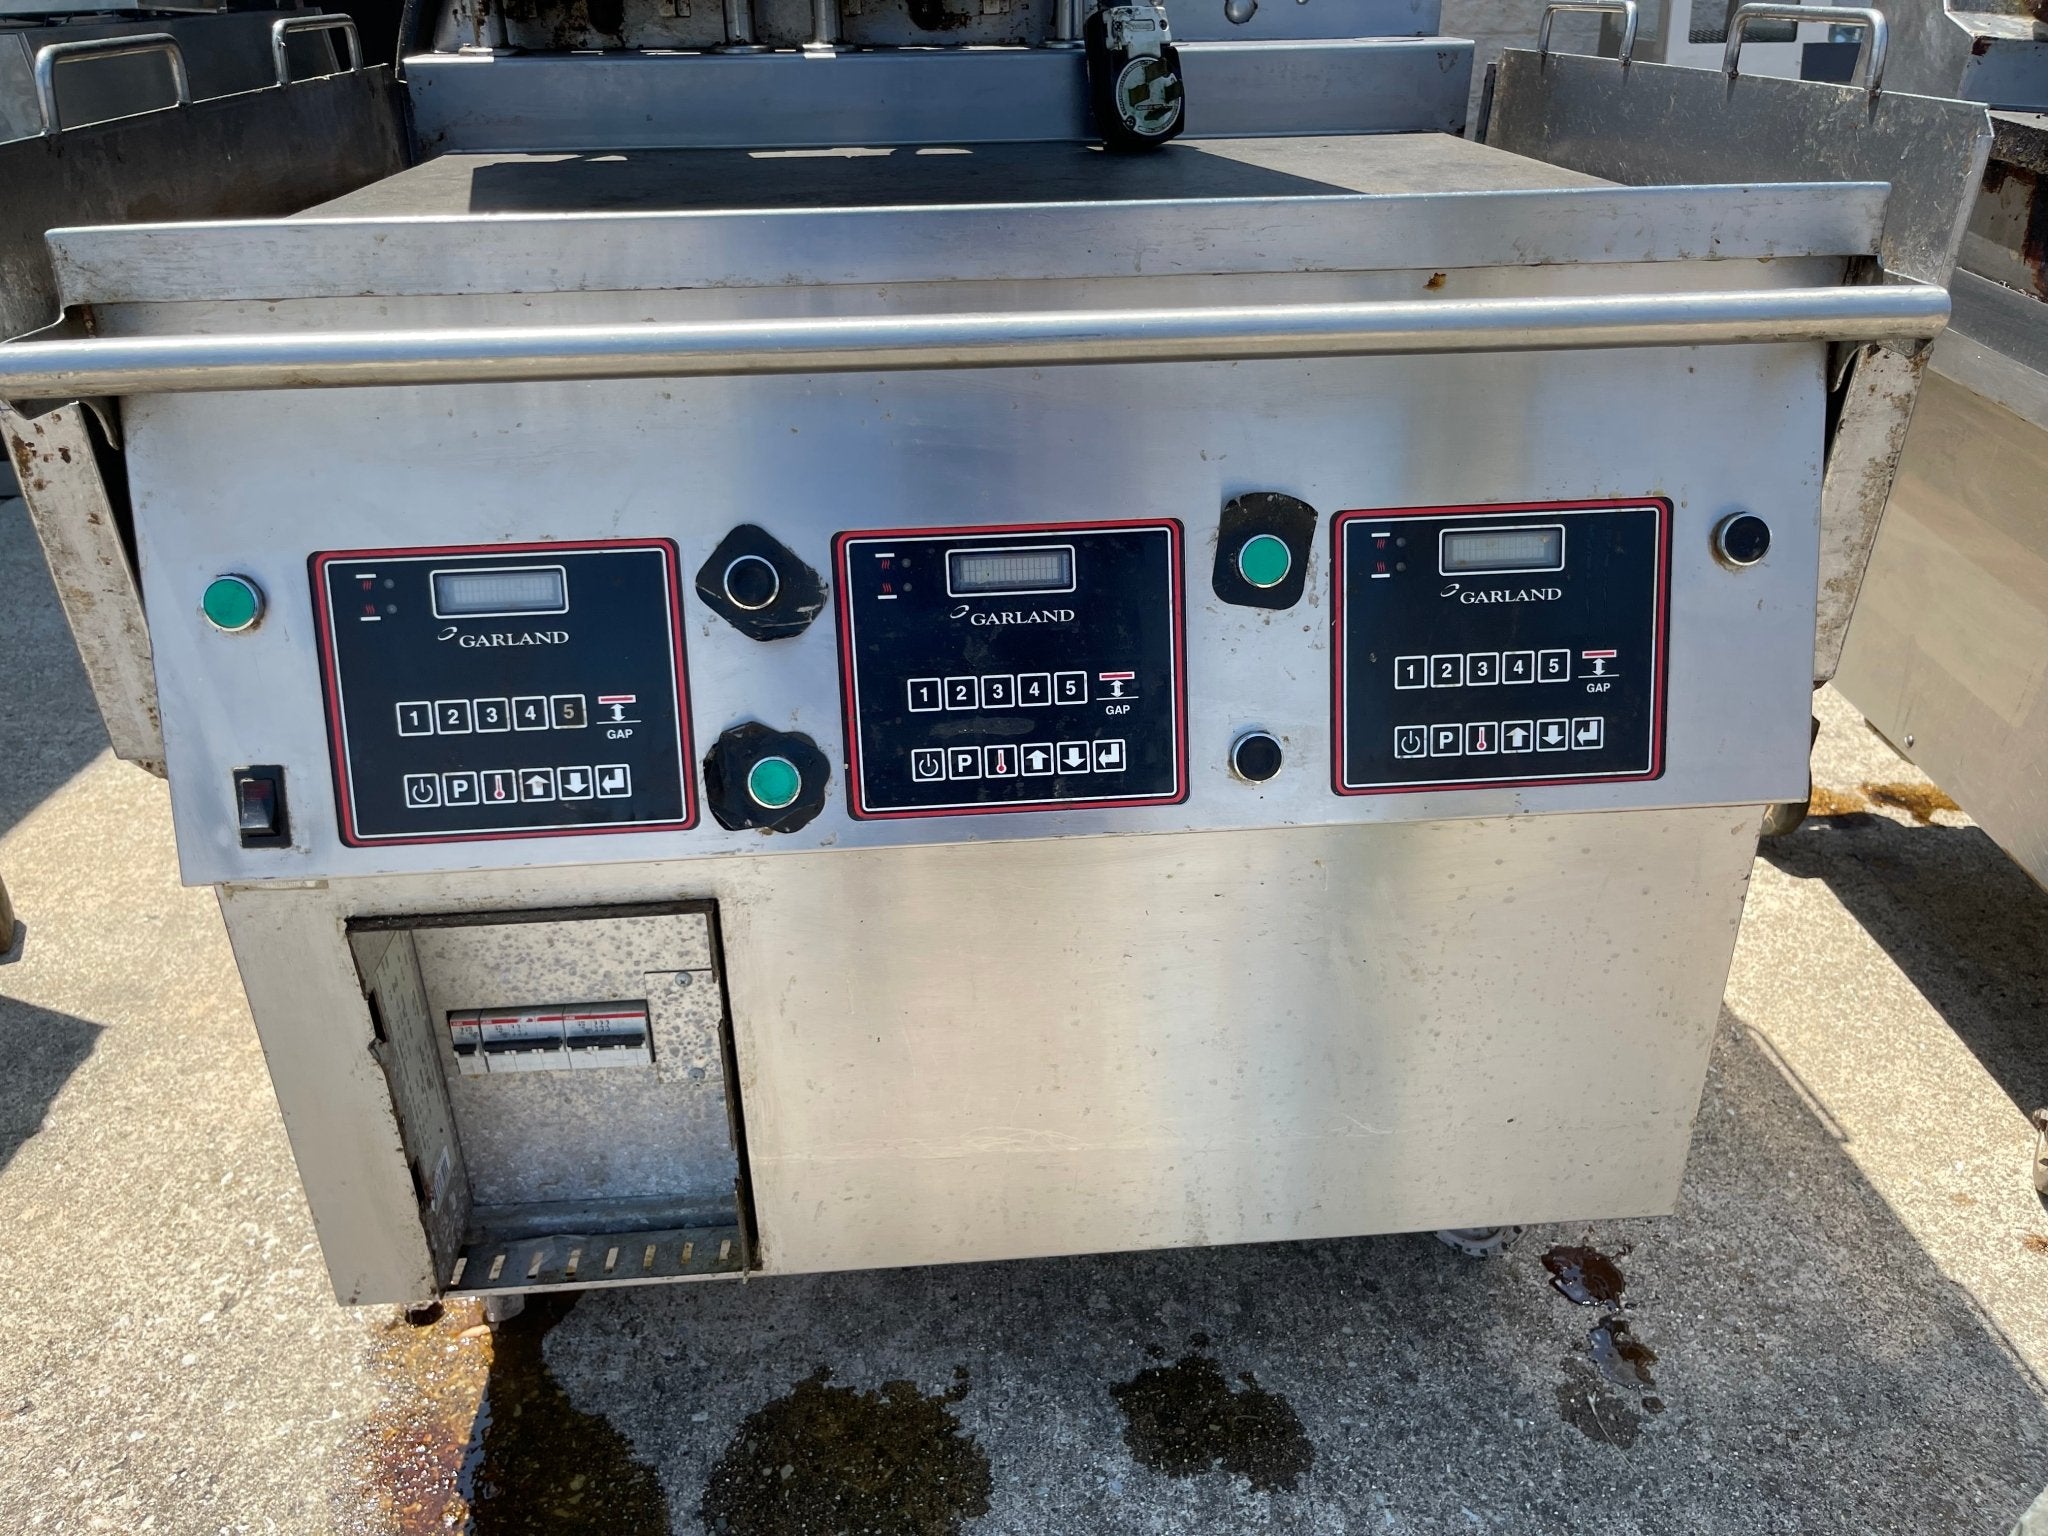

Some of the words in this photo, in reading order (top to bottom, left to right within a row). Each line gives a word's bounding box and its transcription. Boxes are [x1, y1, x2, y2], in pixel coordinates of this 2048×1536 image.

[1459, 587, 1562, 604] GARLAND
[970, 609, 1075, 626] GARLAND
[459, 630, 570, 648] GARLAND
[1406, 664, 1414, 680] 1
[1441, 662, 1453, 678] 2
[1477, 661, 1488, 677] 3
[1512, 659, 1524, 675] 4
[1548, 658, 1560, 674] 5
[919, 686, 928, 702] 1
[956, 685, 967, 701] 2
[992, 683, 1004, 699] 3
[1028, 681, 1041, 697] 4
[1065, 680, 1077, 696] 5
[1586, 682, 1611, 693] GAP
[409, 710, 419, 726] 1
[447, 708, 460, 725] 2
[486, 707, 498, 723] 3
[524, 705, 537, 721] 4
[563, 703, 575, 719] 5
[1105, 704, 1131, 716] GAP
[606, 728, 634, 740] GAP
[1439, 731, 1454, 750] P
[957, 754, 973, 773] P
[452, 779, 469, 799] P
